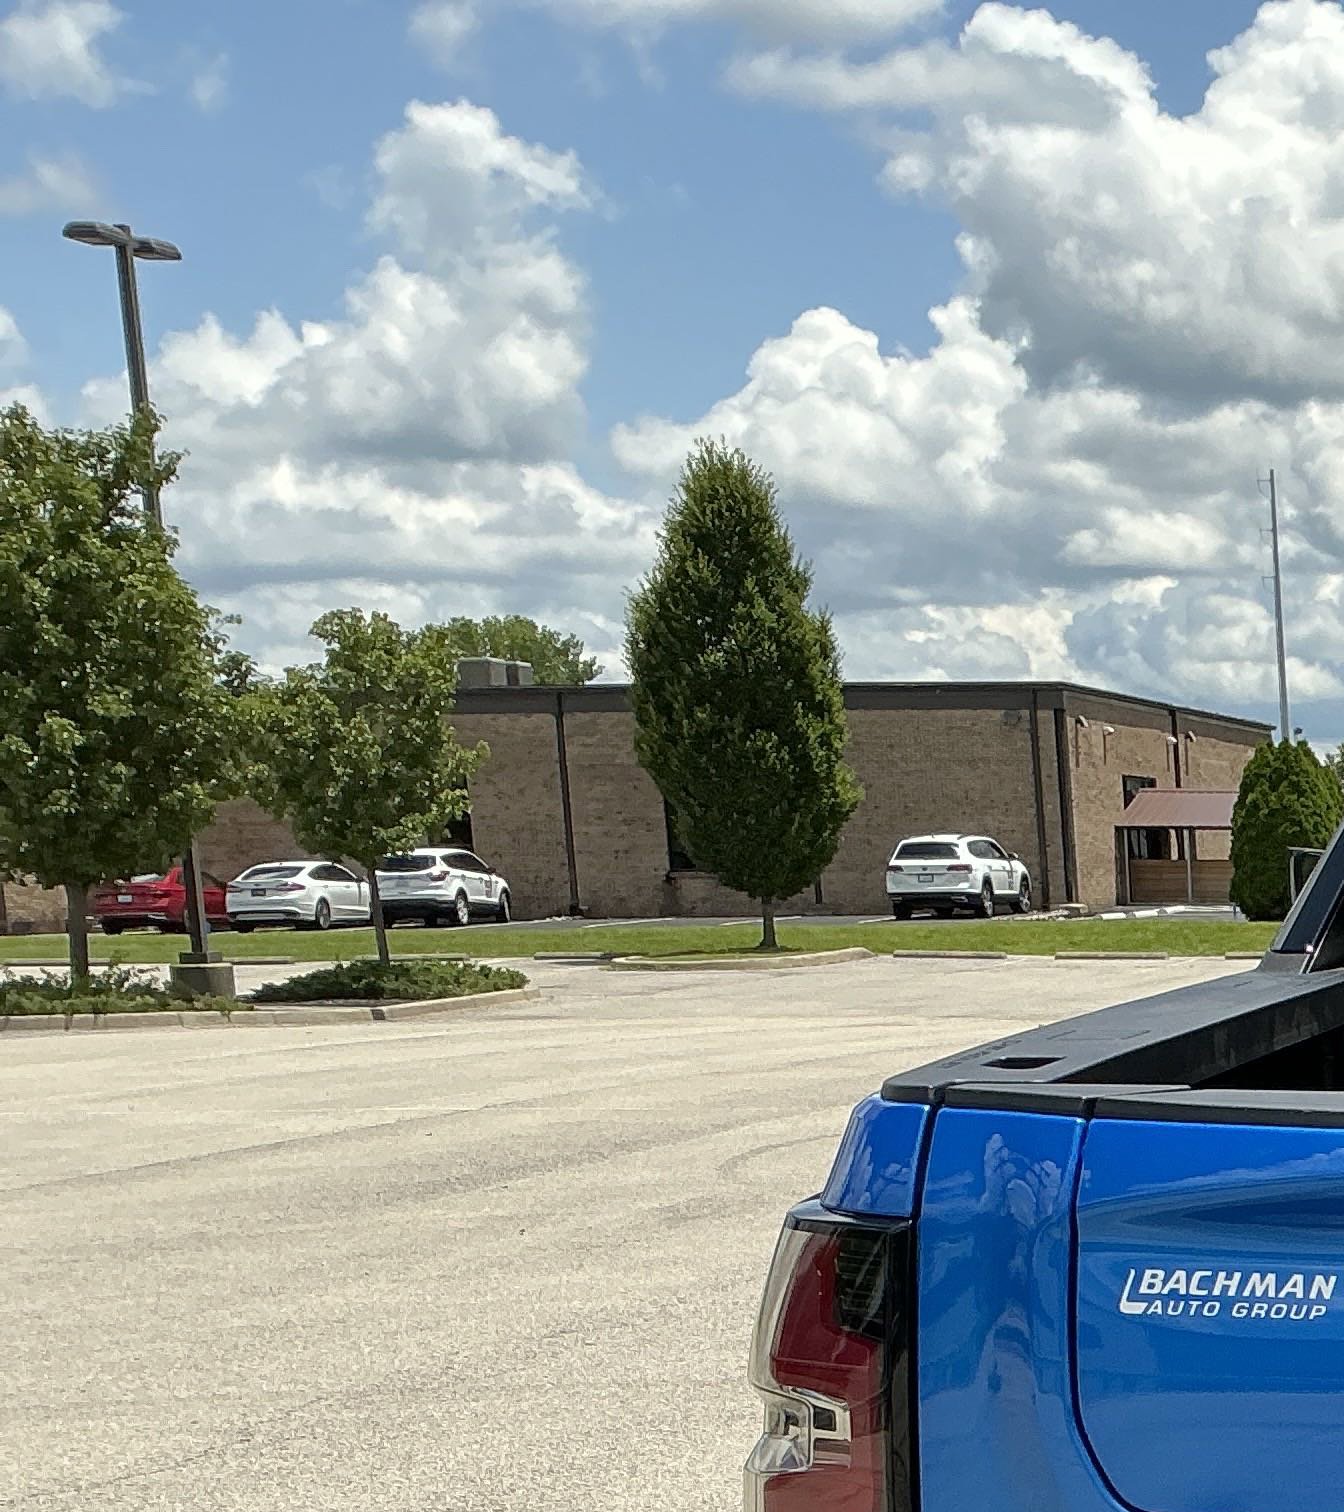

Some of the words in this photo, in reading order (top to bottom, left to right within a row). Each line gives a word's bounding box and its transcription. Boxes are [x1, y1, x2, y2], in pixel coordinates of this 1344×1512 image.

[1138, 1268, 1338, 1300] BACHMAN
[1146, 1300, 1220, 1318] AUTO
[1231, 1302, 1327, 1321] GROUP
